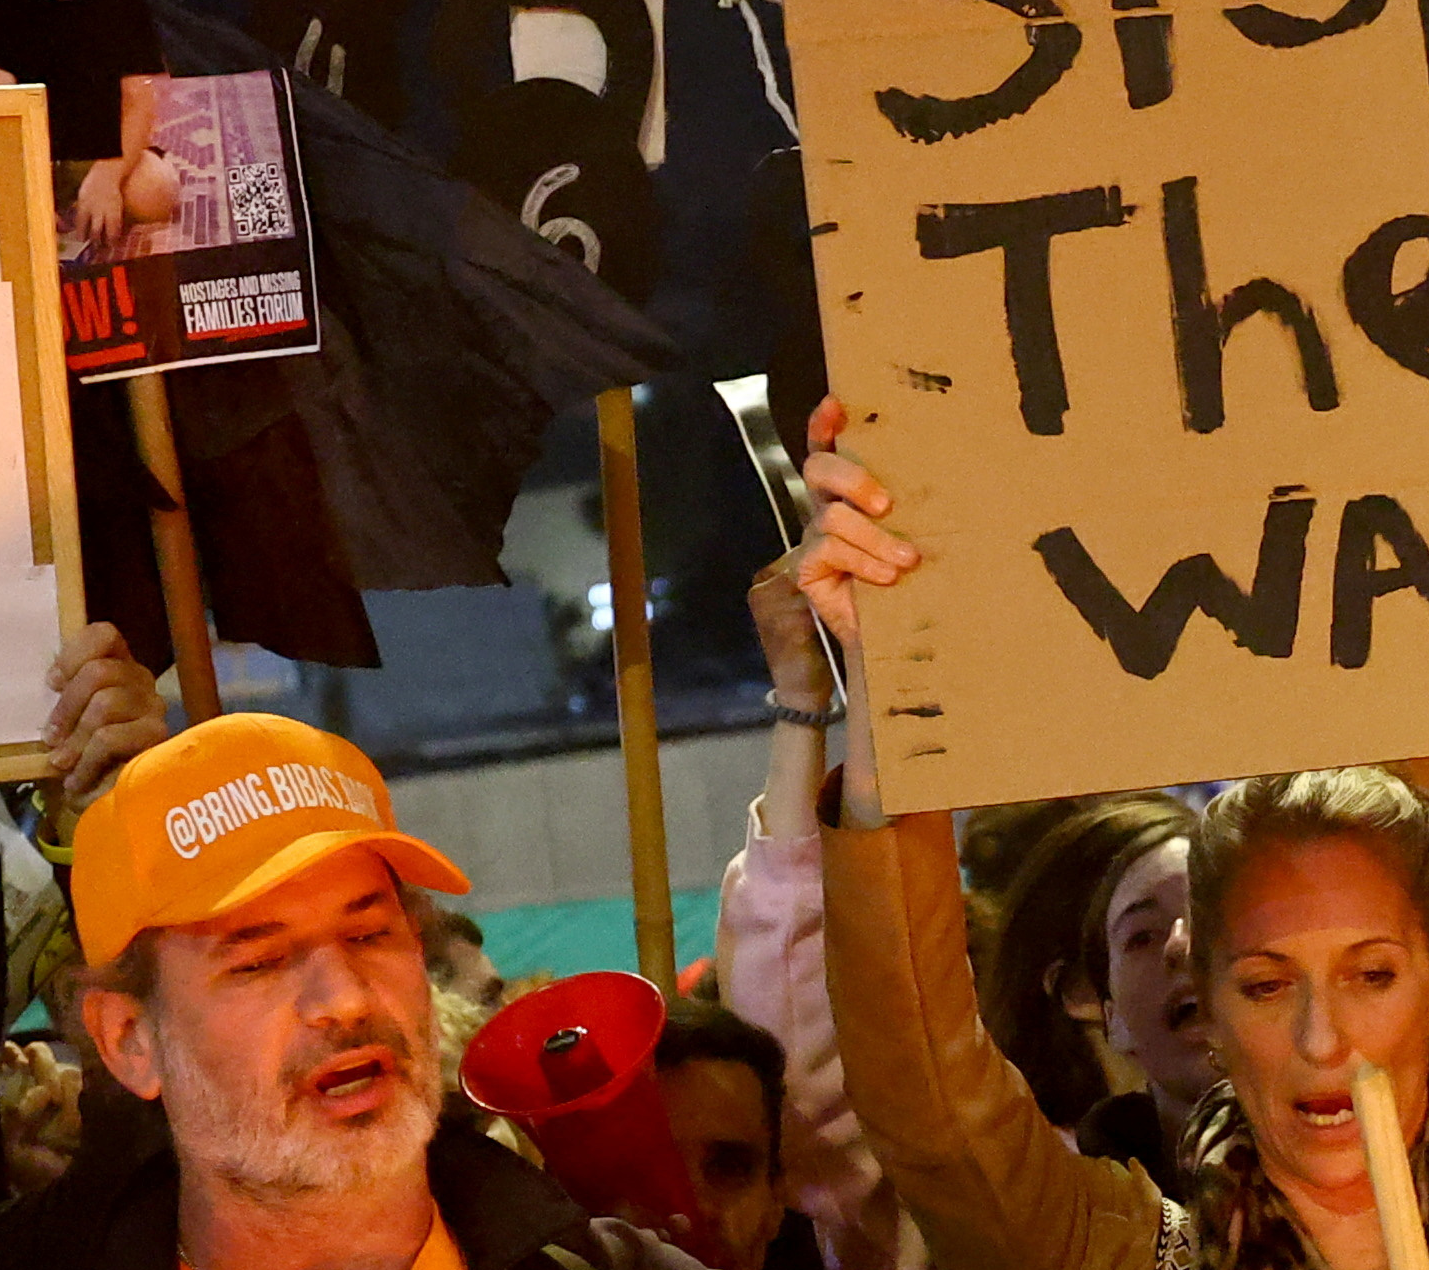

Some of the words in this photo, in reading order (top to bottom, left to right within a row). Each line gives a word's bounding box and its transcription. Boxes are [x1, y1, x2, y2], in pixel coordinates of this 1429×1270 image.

[179, 277, 239, 303] HOSTAGES
[184, 296, 257, 334] FAMILIES
[257, 291, 305, 326] FORUM
